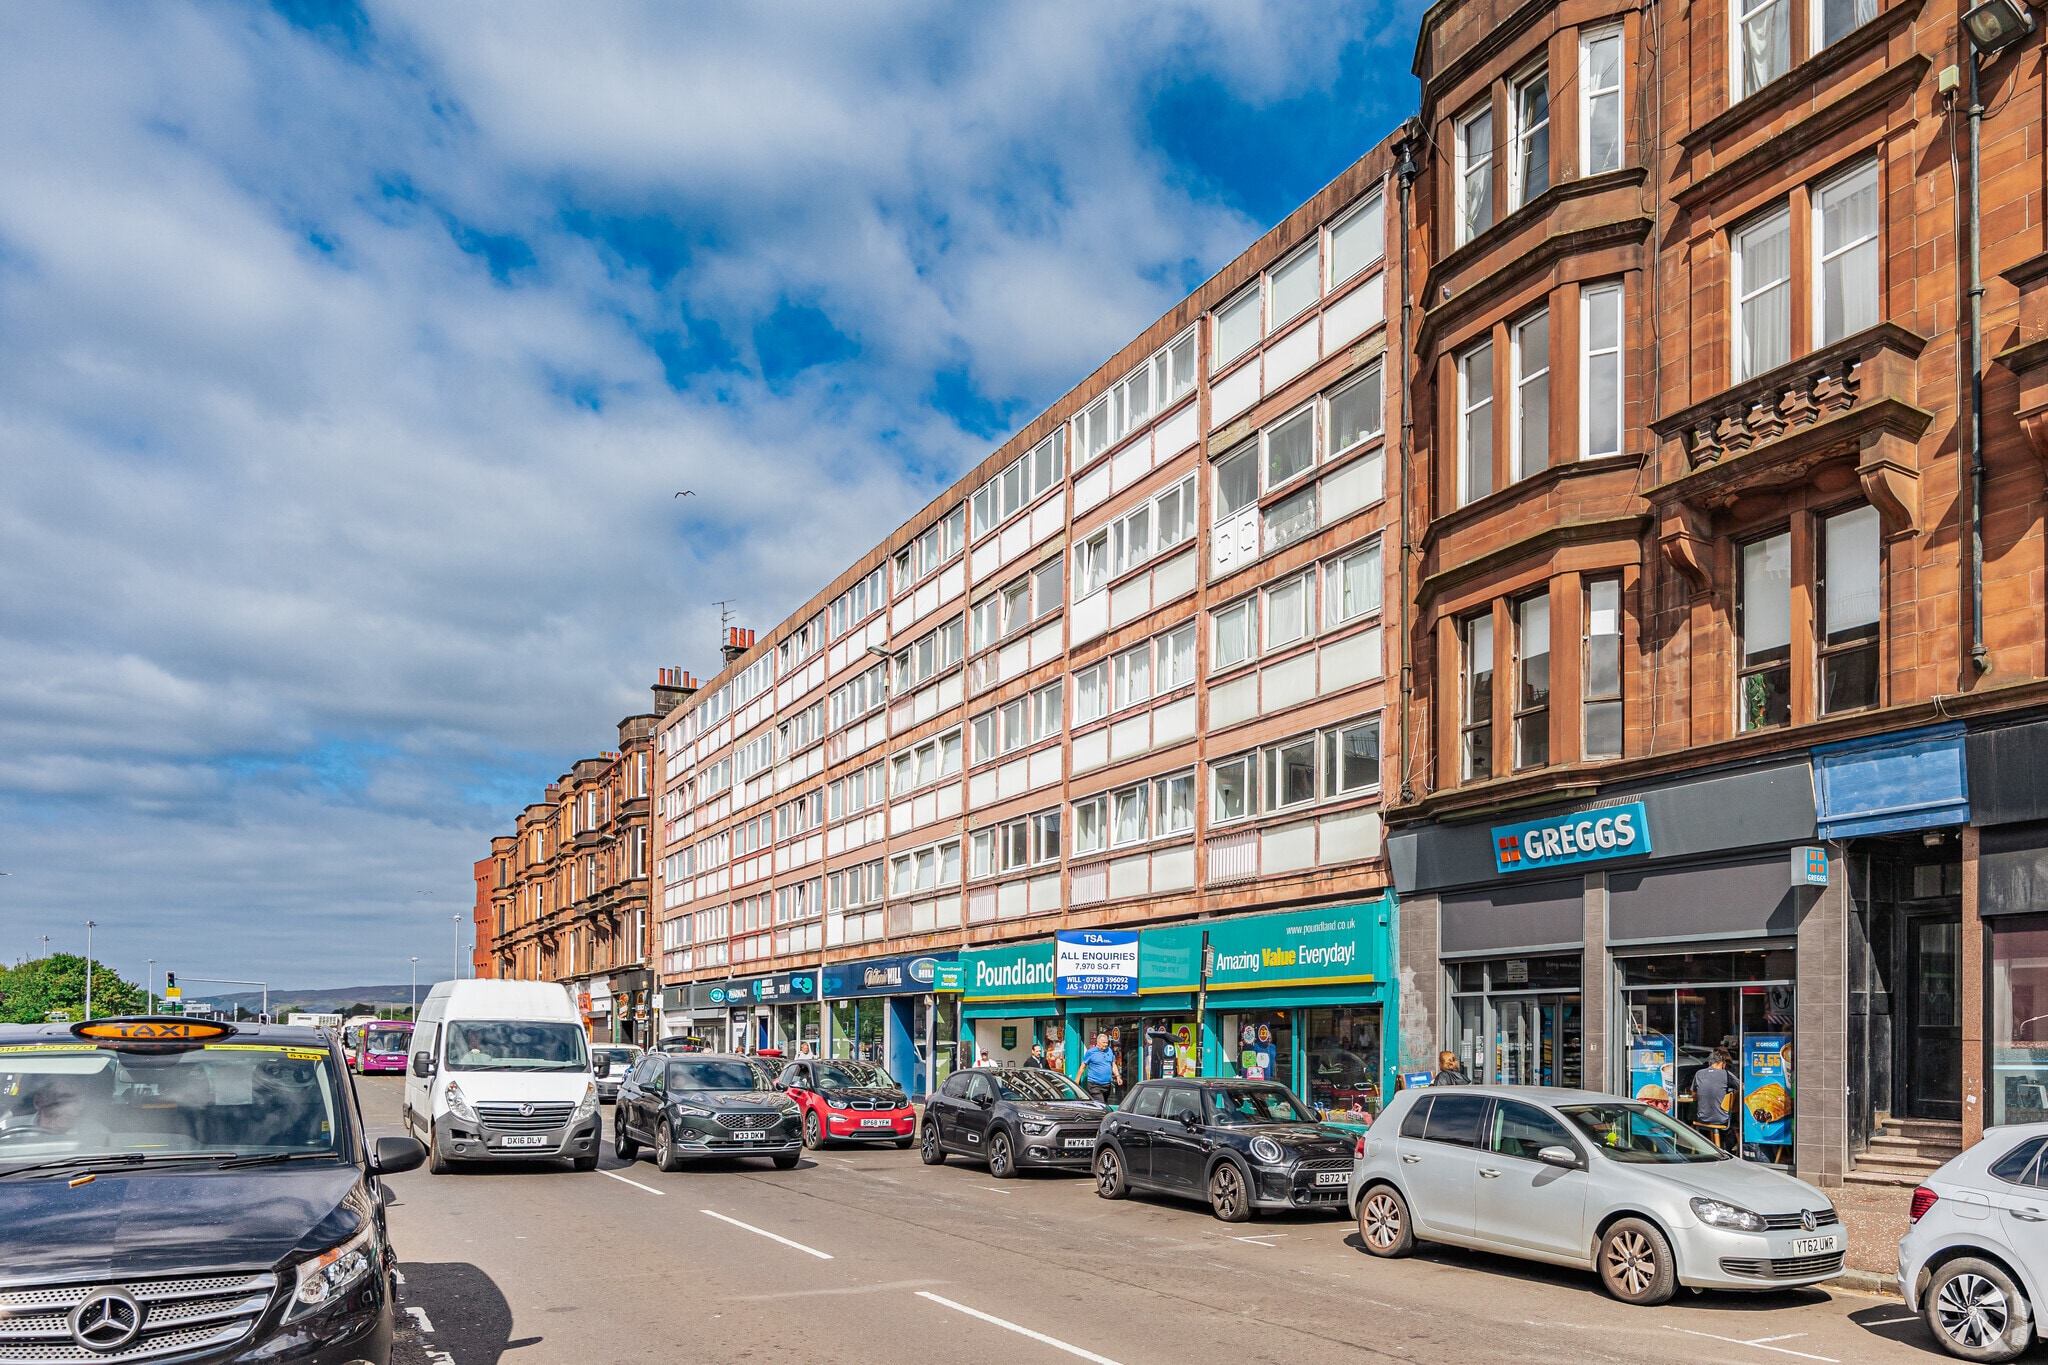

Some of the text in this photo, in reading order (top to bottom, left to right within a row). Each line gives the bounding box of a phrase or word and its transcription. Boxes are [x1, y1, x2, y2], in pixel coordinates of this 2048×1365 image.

[1524, 814, 1635, 859] GREGGS
[1807, 874, 1827, 882] GREGGS
[1286, 918, 1356, 935] www.poundland.co.uk
[1084, 934, 1104, 943] TSA
[1060, 952, 1136, 961] ALL ENQUIRIES
[1216, 951, 1260, 972] Amazing
[1262, 947, 1296, 967] Value
[1298, 941, 1356, 967] Everyday!
[976, 955, 1054, 987] Poundland
[1075, 963, 1096, 971] 7,970
[887, 967, 902, 985] HILL
[114, 1025, 190, 1037] TAXI
[1753, 1054, 1781, 1067] £3.55
[507, 1137, 525, 1145] DX16
[1319, 1173, 1340, 1183] SB72
[1796, 1239, 1818, 1253] YT62
